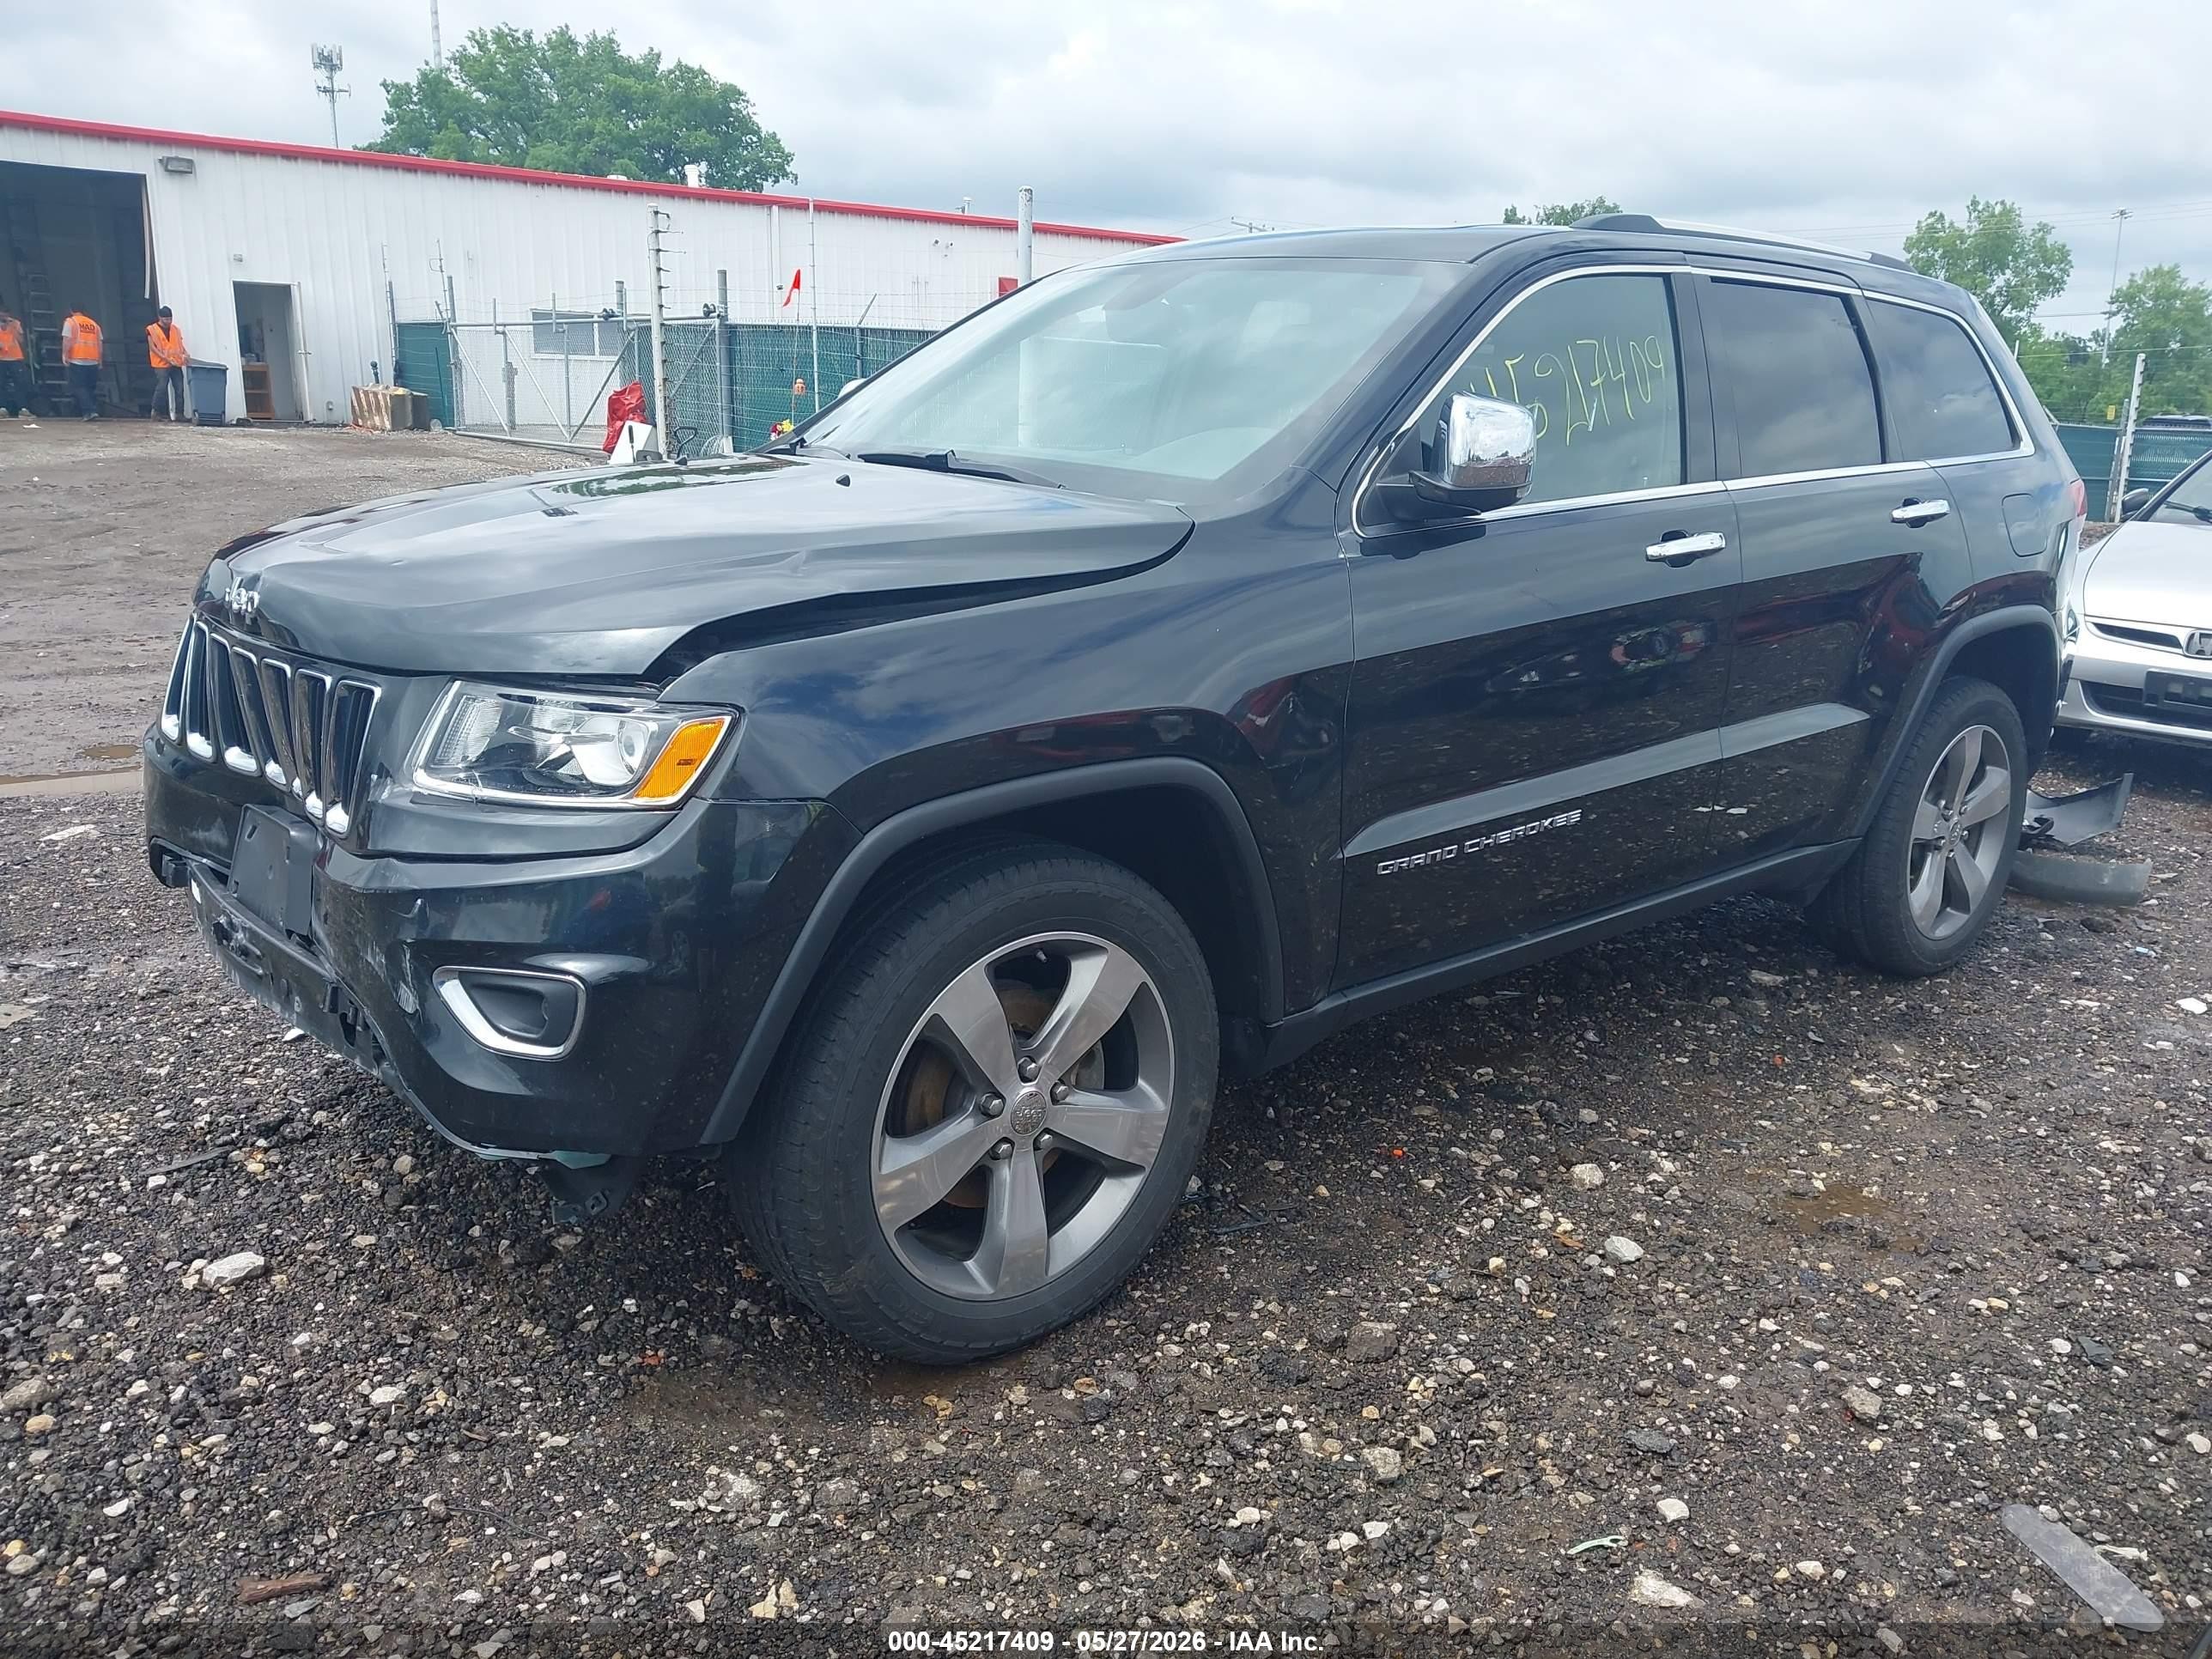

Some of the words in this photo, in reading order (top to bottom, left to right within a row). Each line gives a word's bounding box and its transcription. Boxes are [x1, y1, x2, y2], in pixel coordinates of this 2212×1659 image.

[1469, 335, 1665, 447] 5217409
[1376, 845, 1458, 875] GRAND
[1463, 809, 1583, 854] CHEROKEE
